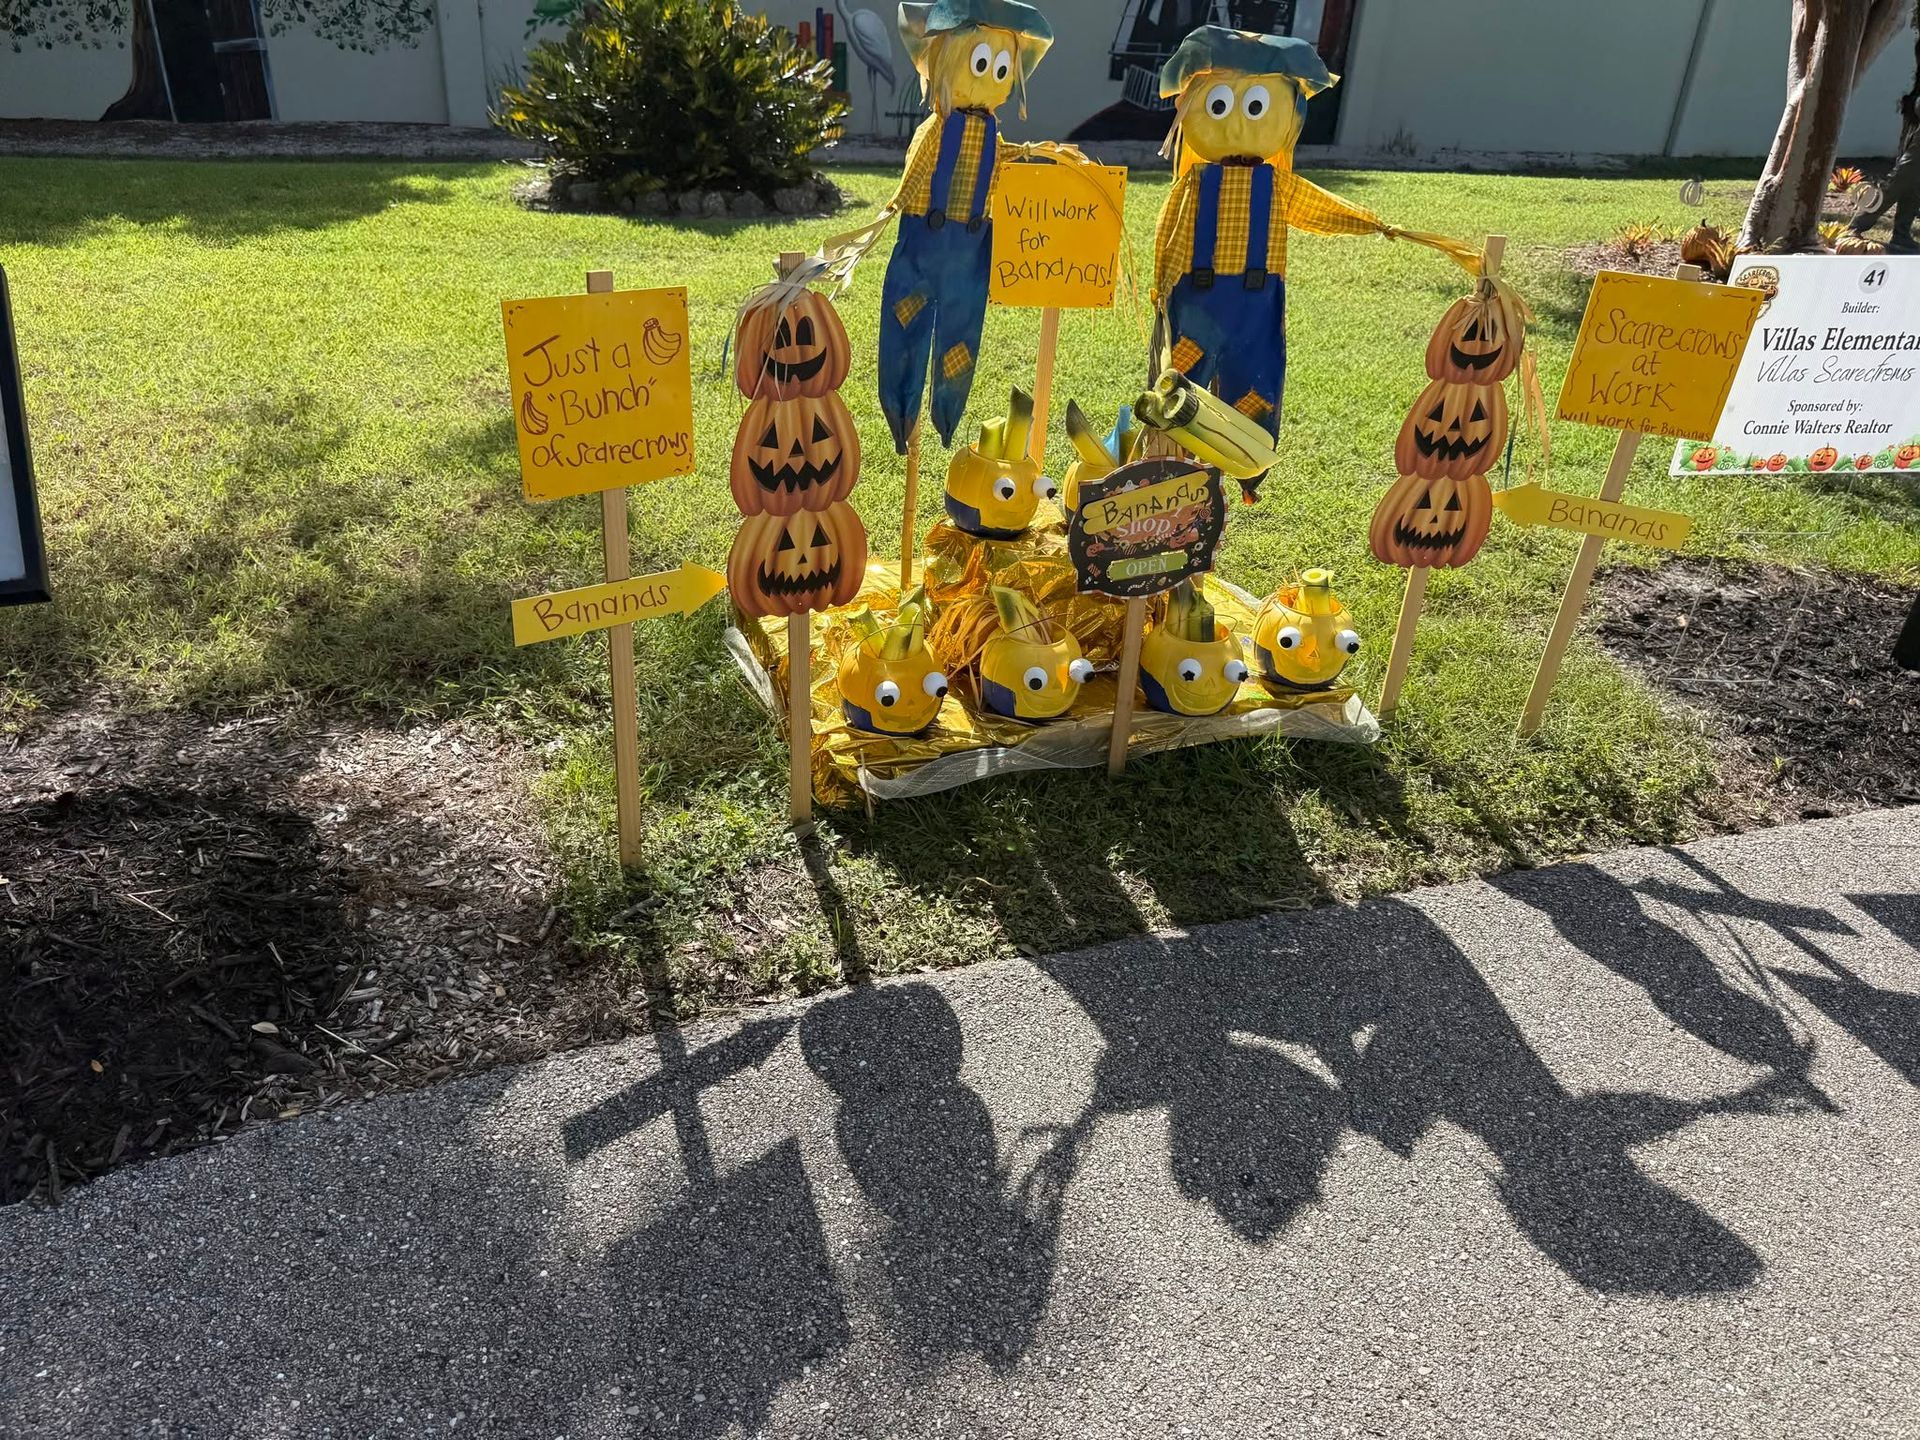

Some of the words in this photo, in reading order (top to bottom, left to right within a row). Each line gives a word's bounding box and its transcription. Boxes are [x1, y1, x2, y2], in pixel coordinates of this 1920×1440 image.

[1005, 194, 1047, 222] Will
[1017, 228, 1050, 253] for
[996, 252, 1115, 288] Bananas!
[1863, 269, 1886, 287] 41
[1841, 301, 1880, 314] Builder:
[1594, 308, 1743, 360] Scarecrows
[1762, 327, 1817, 351] Villas
[523, 335, 600, 386] Just
[611, 342, 631, 369] a
[1632, 352, 1661, 376] at
[1757, 354, 1808, 383] Villas
[548, 374, 657, 425] "Bunch"
[1588, 371, 1676, 412] Work
[1787, 399, 1845, 415] Sponsored
[1846, 399, 1863, 415] by:
[1639, 417, 1657, 433] for
[1743, 420, 1789, 435] Connie
[1794, 419, 1842, 434] Walters
[1844, 419, 1893, 434] Realtor
[531, 433, 567, 468] of
[1547, 499, 1669, 541] Bananas
[1126, 557, 1167, 577] OPEN
[533, 583, 671, 632] Bananas
